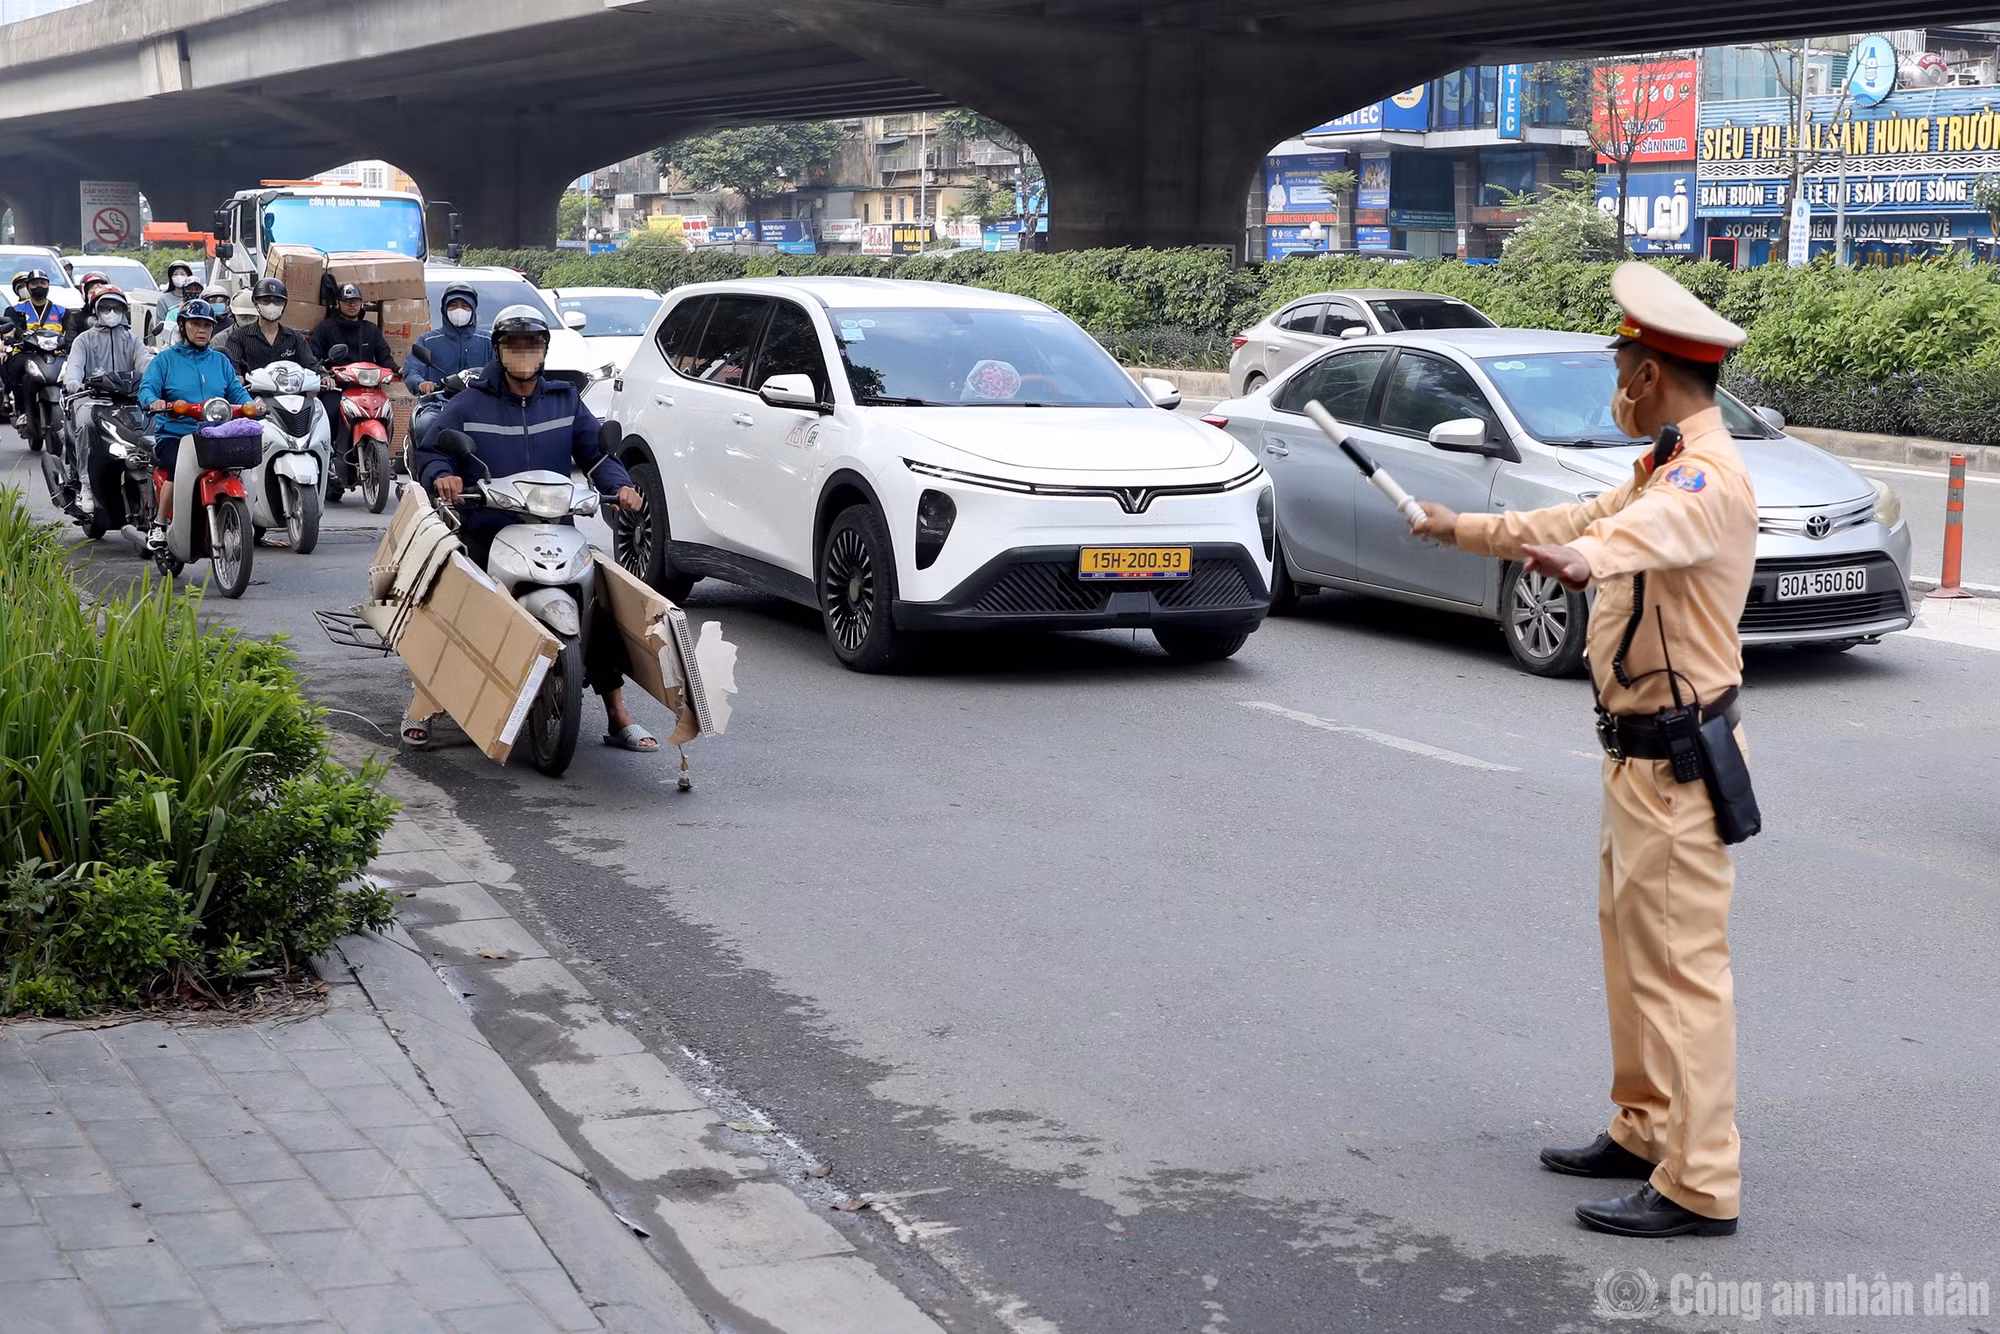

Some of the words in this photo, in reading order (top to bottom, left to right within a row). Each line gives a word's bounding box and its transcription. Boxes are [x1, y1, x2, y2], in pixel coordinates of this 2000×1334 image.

[1703, 119, 1746, 160] SIÊU
[1826, 108, 1868, 155] SẢN
[1873, 110, 1930, 154] HÙNG
[1662, 138, 1688, 154] NHỰA
[1701, 181, 1727, 206] BÁN
[1730, 180, 1764, 205] BUÔN
[1827, 183, 1851, 204] HI
[1855, 176, 1884, 203] SẢN
[1888, 180, 1921, 202] TƯƠI
[1926, 174, 1967, 201] SỐNG
[1725, 222, 1742, 238] SƠ
[1744, 219, 1770, 238] CHẾ
[1860, 218, 1886, 238] SẢN
[1888, 222, 1930, 238] MANG
[1934, 217, 1950, 237] VỀ
[1093, 552, 1181, 568] 15H-200.93
[1781, 571, 1864, 597] 30A-560.60
